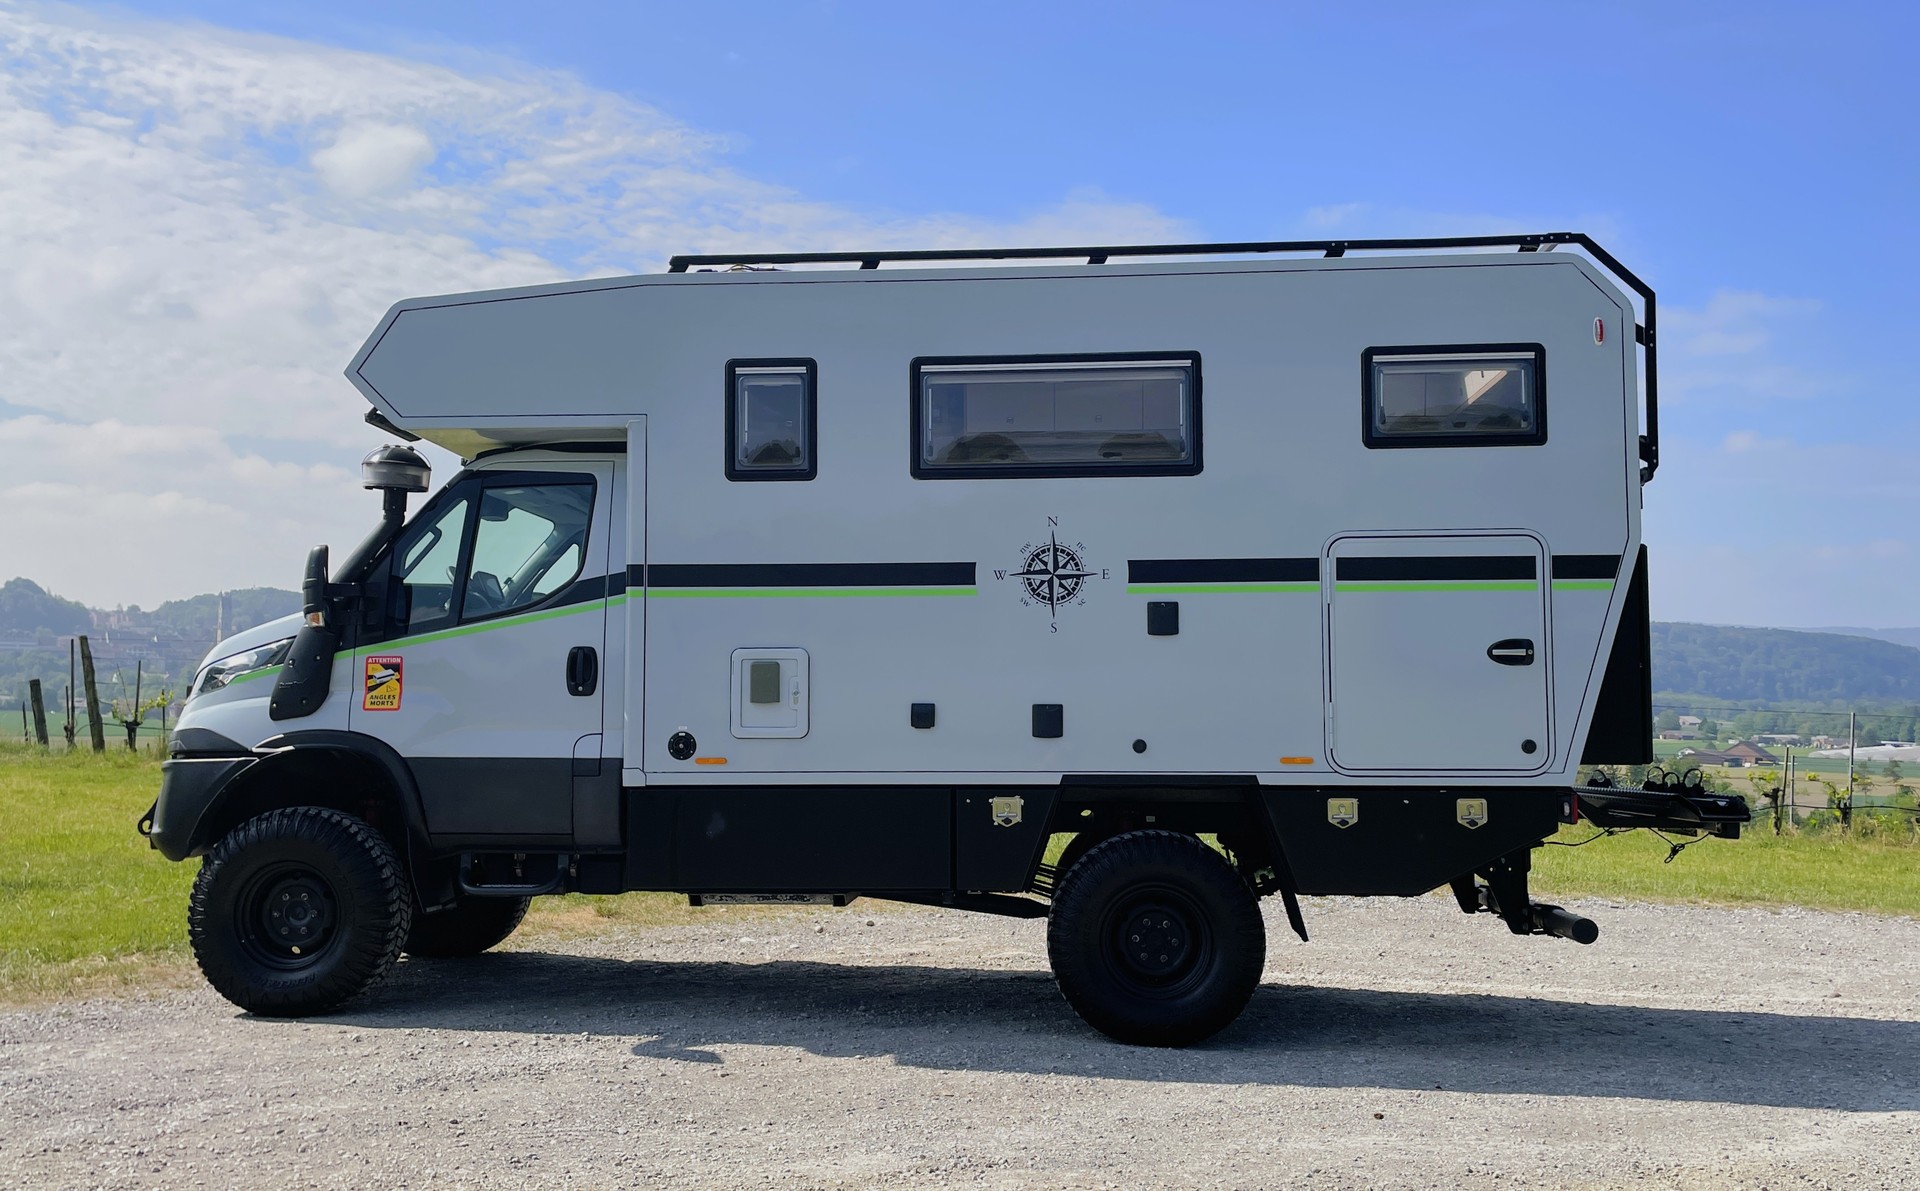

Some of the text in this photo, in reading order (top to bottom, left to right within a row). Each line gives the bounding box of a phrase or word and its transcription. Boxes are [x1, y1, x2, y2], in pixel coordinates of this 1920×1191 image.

[1047, 516, 1058, 527] N
[1019, 541, 1032, 555] nw
[993, 570, 1007, 581] W
[1102, 569, 1111, 580] E
[1019, 597, 1031, 607] sw
[1050, 622, 1058, 634] S
